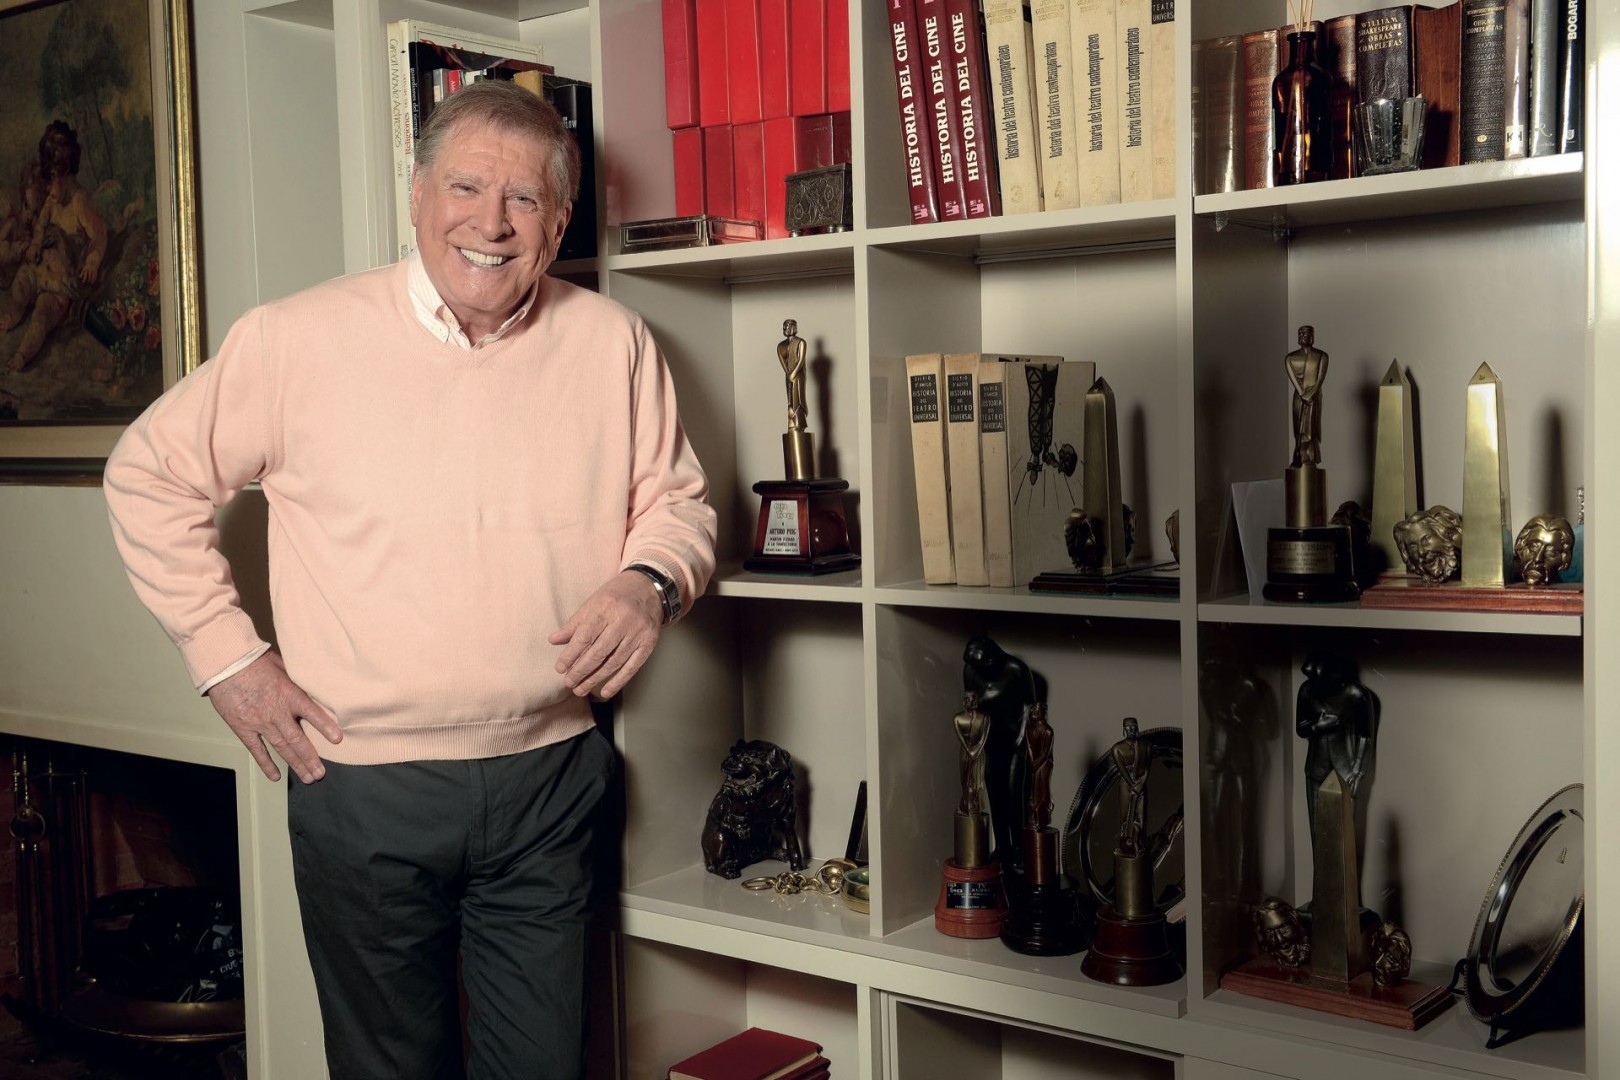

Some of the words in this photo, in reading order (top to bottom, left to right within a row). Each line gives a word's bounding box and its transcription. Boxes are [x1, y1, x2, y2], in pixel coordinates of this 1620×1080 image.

[1152, 3, 1175, 11] TEATR
[1152, 12, 1175, 22] UNIVERS
[1358, 23, 1402, 35] SHAKESPEARE
[1361, 16, 1399, 28] WILLIAM
[1466, 24, 1504, 34] COMPLETAS
[1473, 18, 1496, 26] OBRAS
[1567, 0, 1578, 40] BOGAR
[893, 21, 907, 62] CINE
[925, 16, 940, 57] CINE
[951, 12, 966, 54] CINE
[1368, 32, 1393, 42] OBRAS
[389, 38, 399, 67] Great
[1358, 39, 1403, 52] COMPLETAS
[391, 68, 401, 98] Movie
[898, 65, 913, 99] DEL
[930, 60, 944, 94] DEL
[956, 57, 971, 92] DEL
[1088, 87, 1101, 111] teatro
[1126, 82, 1140, 106] teatro
[1002, 97, 1015, 120] teatro
[1046, 95, 1060, 118] teatro
[1089, 112, 1102, 123] del
[1126, 107, 1141, 119] del
[392, 100, 403, 148] Actresses
[1003, 120, 1016, 132] del
[1048, 119, 1061, 130] del
[1126, 119, 1142, 148] historia
[904, 103, 923, 187] HISTORIA
[935, 98, 954, 184] HISTORIA
[960, 95, 980, 182] HISTORIA
[1005, 132, 1020, 160] historia
[1048, 131, 1063, 159] historia
[1089, 124, 1103, 152] historia
[912, 389, 936, 397] HISTORIA
[949, 389, 972, 397] HISTORIA
[982, 399, 1002, 407] HISTORIA
[982, 413, 1003, 421] TEATRO
